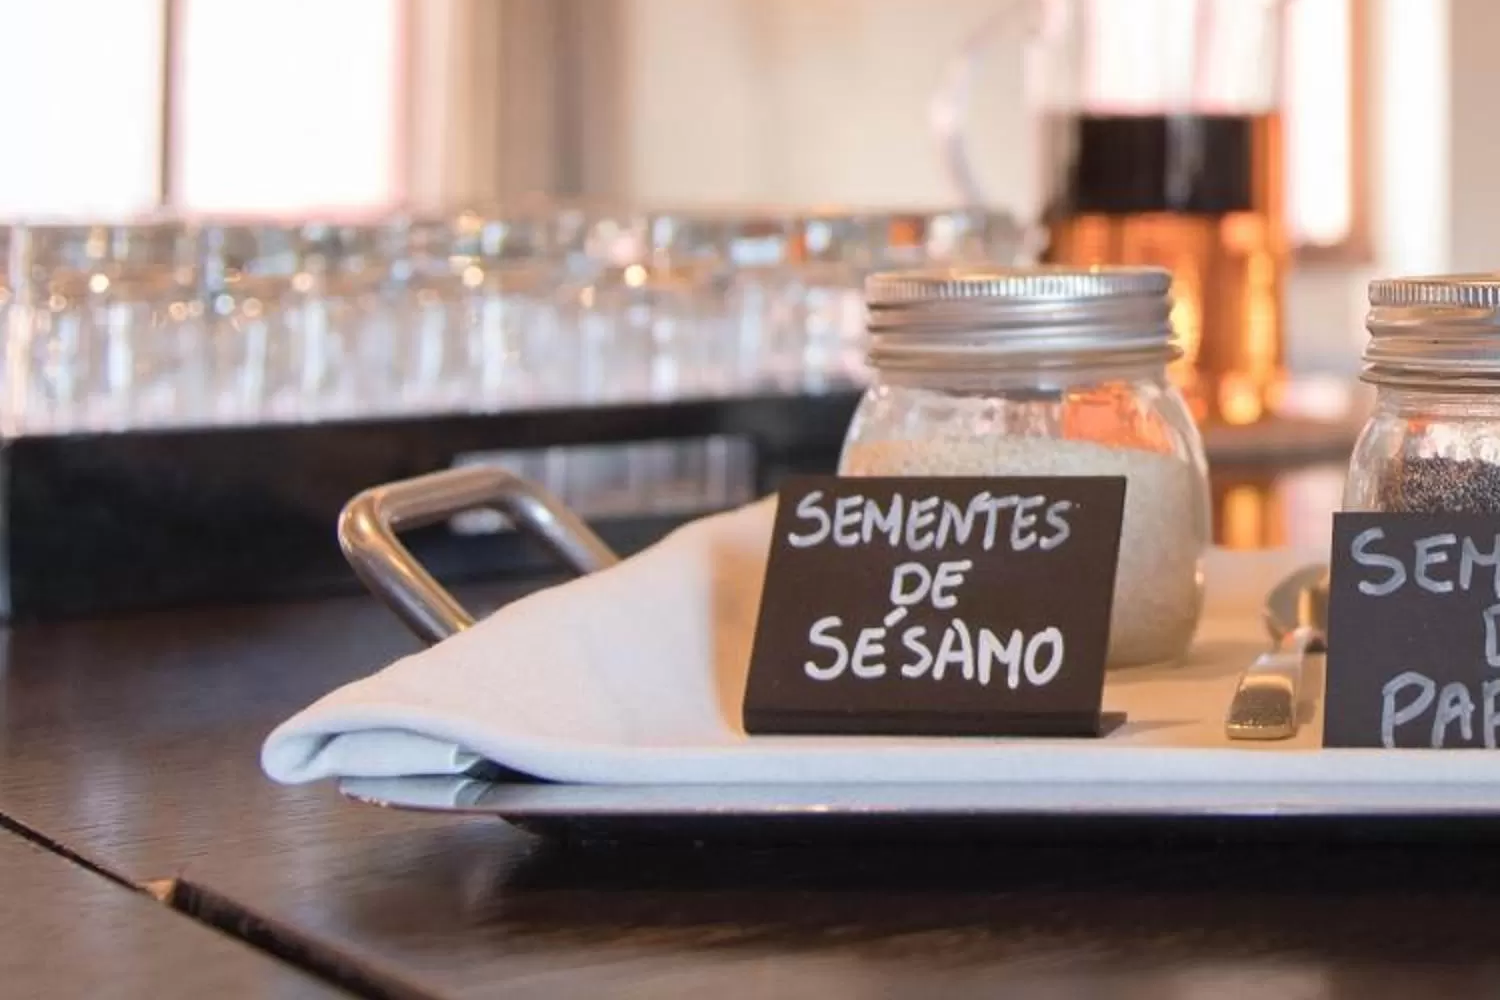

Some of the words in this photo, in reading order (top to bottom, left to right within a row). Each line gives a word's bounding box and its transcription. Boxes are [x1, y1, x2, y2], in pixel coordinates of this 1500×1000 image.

[788, 490, 1072, 551] SEMENTES
[890, 560, 973, 608] DE
[804, 607, 1064, 689] SÉSAMO
